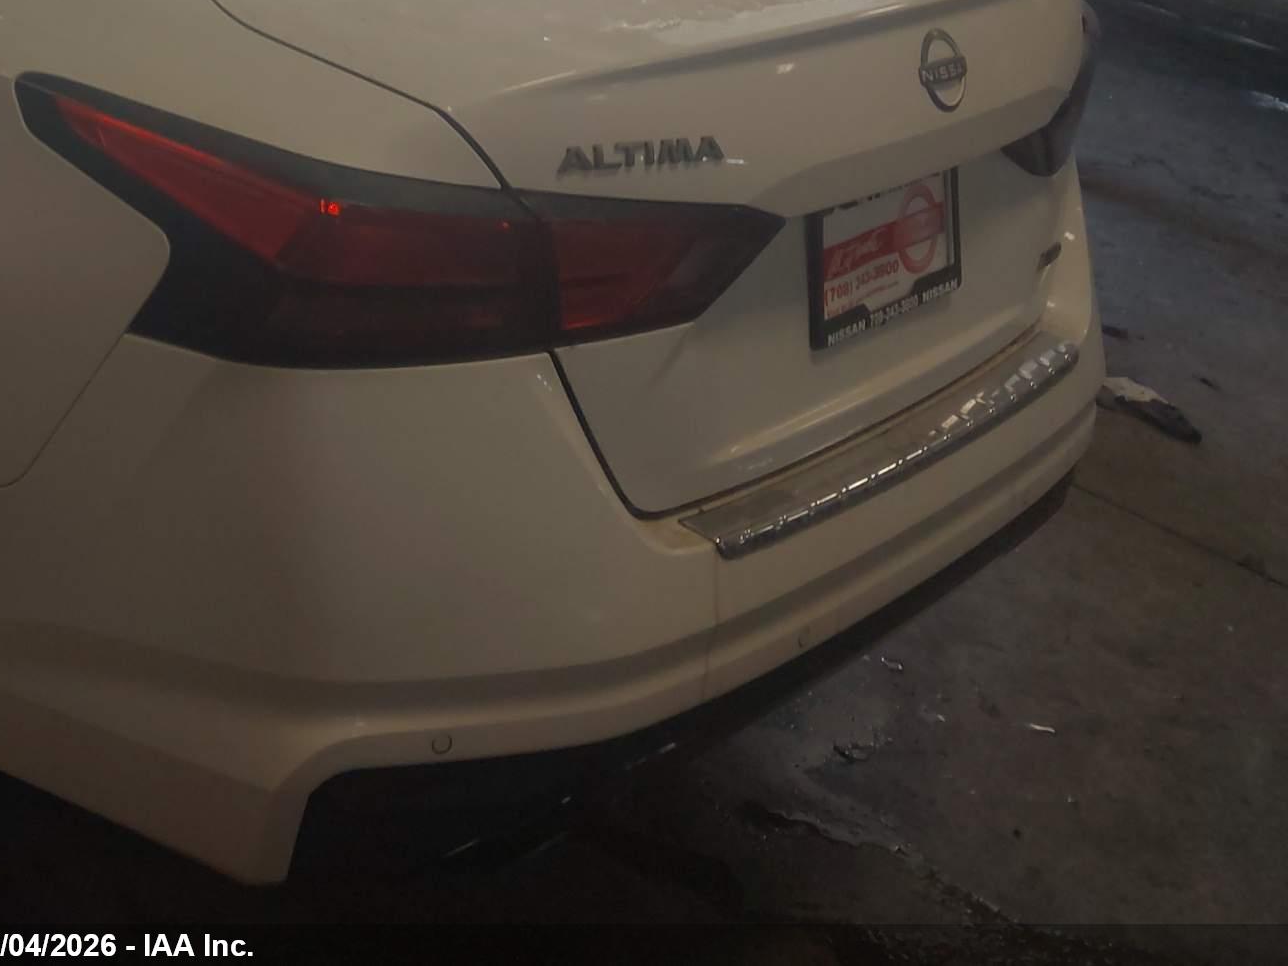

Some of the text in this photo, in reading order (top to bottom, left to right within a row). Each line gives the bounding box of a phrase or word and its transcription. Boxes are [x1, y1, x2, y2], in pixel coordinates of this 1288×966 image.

[920, 63, 963, 84] NISS
[556, 135, 725, 175] ALTIMA
[827, 318, 866, 347] NISSAN
[922, 278, 959, 303] NISSAN
